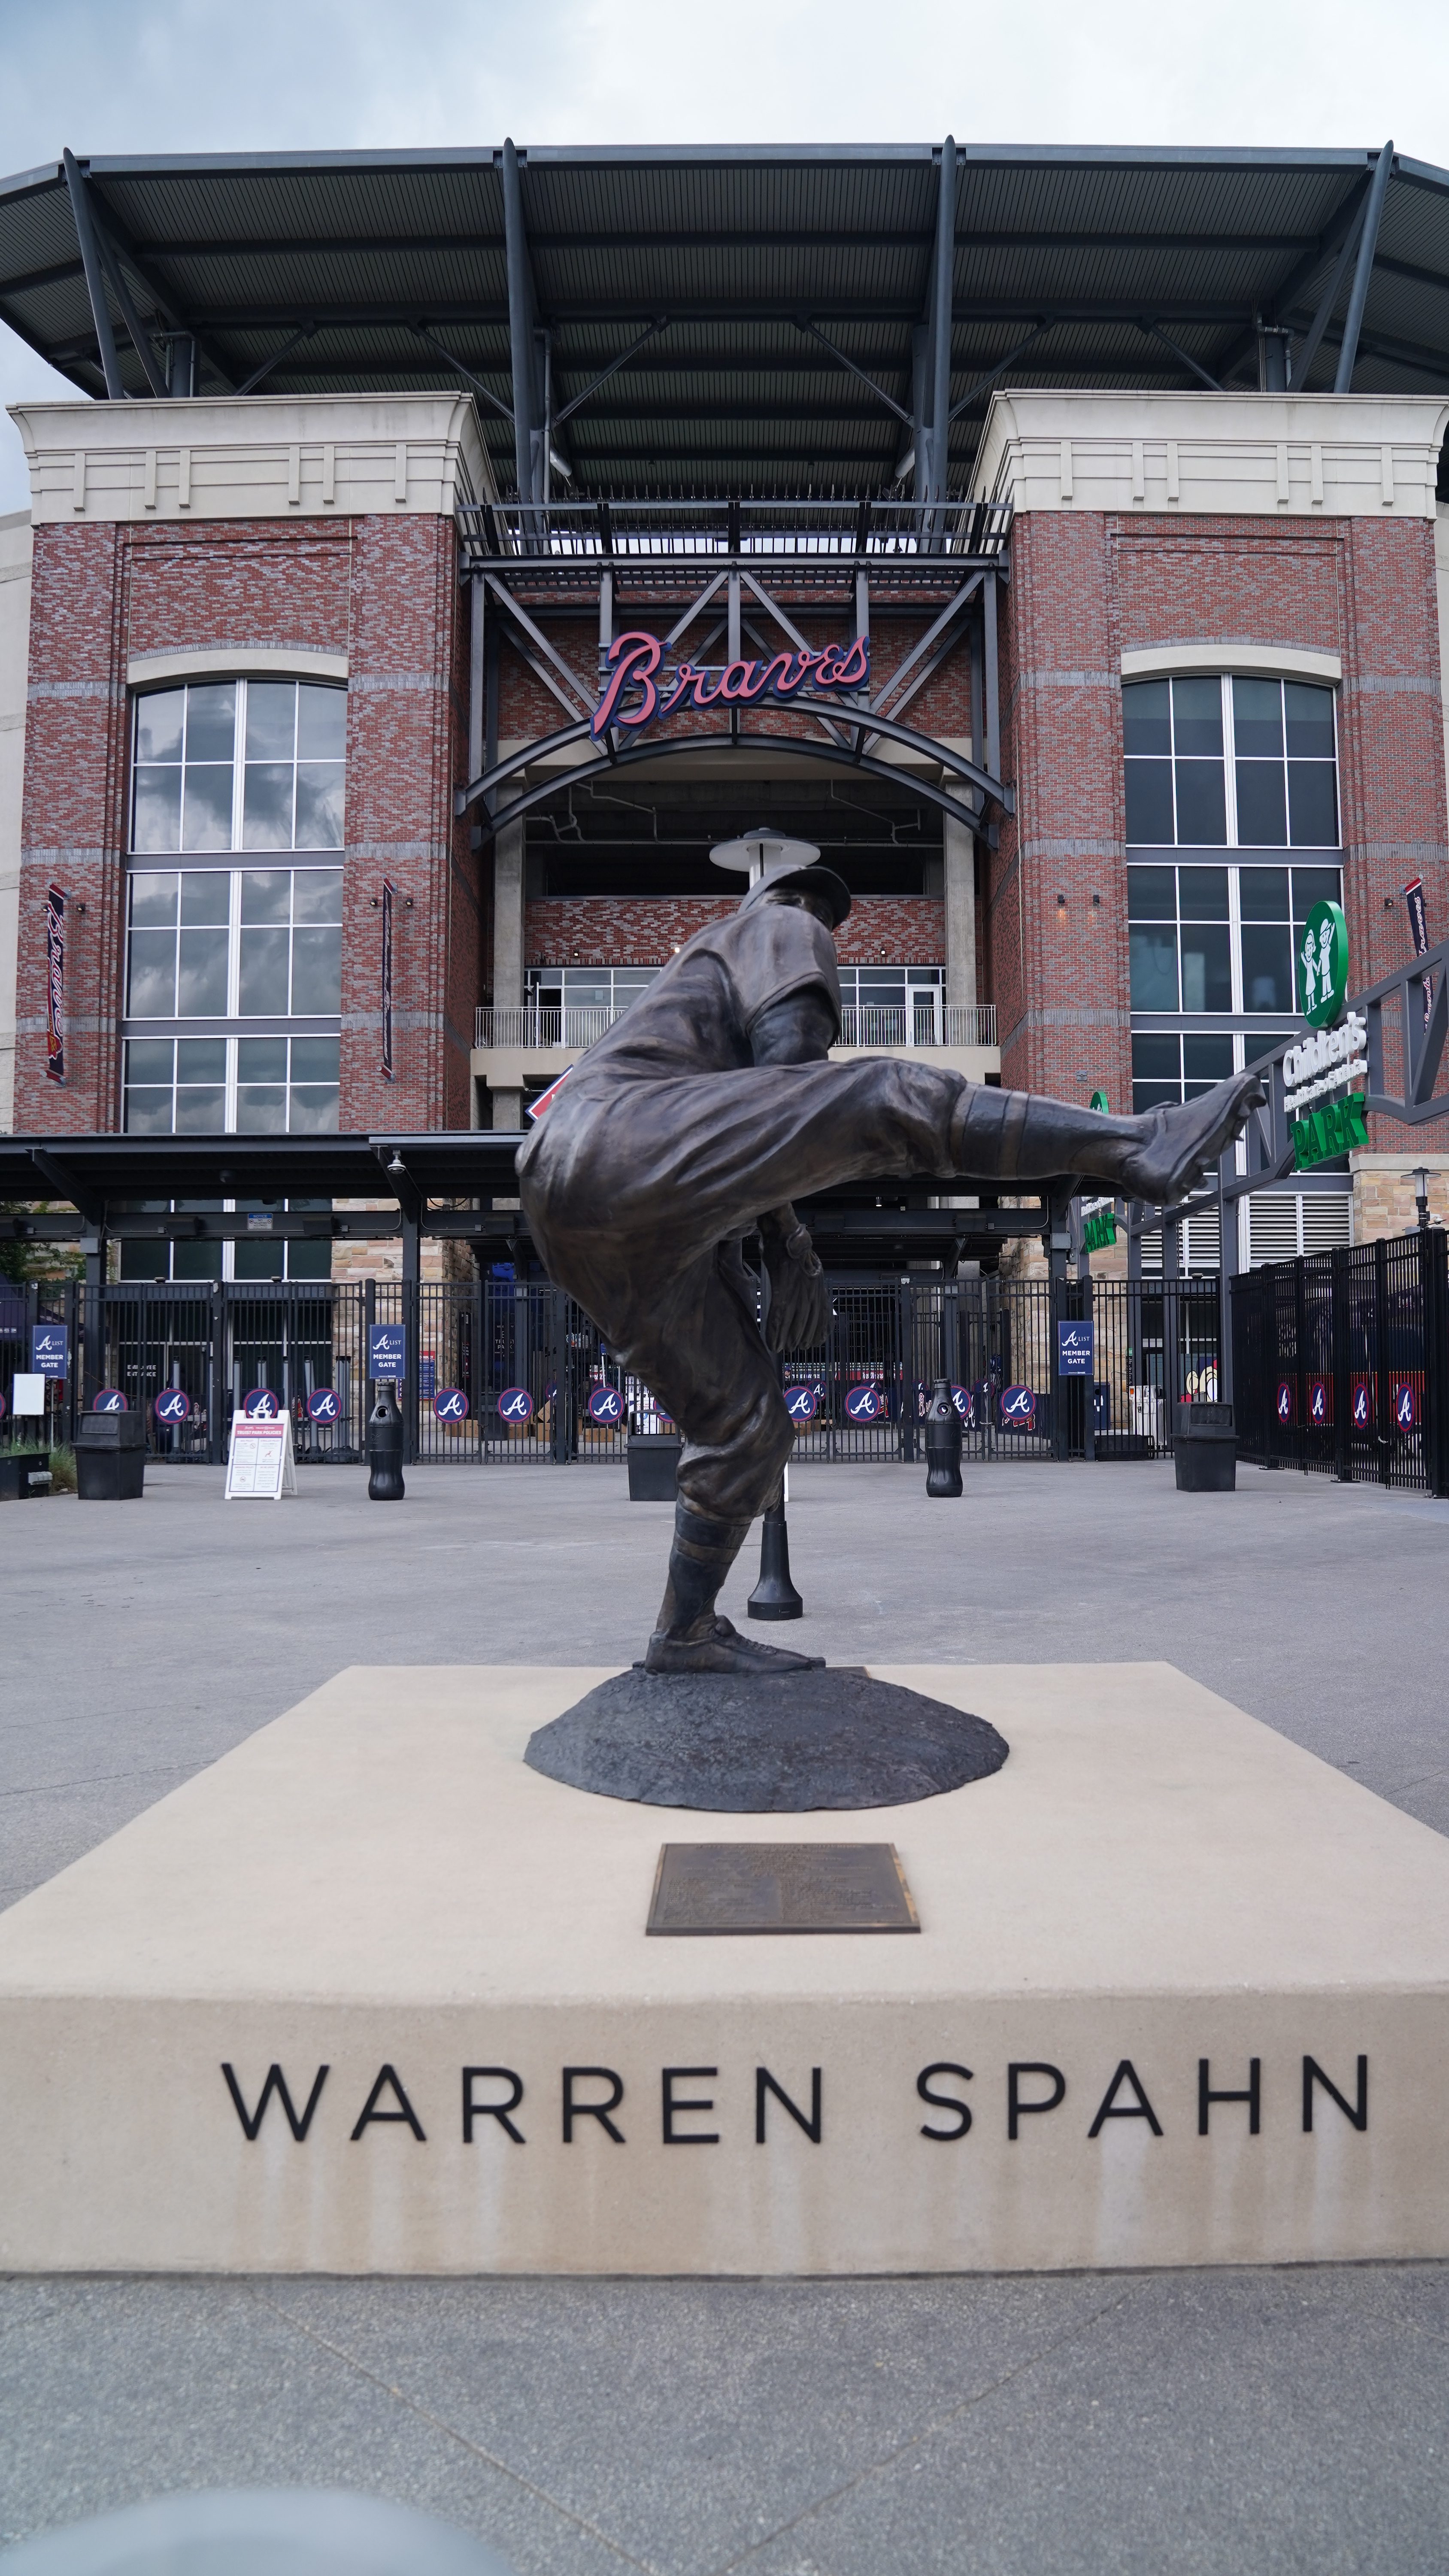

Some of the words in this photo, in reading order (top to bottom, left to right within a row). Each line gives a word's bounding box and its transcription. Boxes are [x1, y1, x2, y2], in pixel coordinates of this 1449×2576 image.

[590, 631, 871, 741] Braves
[1283, 1011, 1367, 1087] Children's
[1284, 1082, 1326, 1113] Healthcare
[1334, 1059, 1367, 1087] Atlanta
[1290, 1093, 1369, 1171] PARK
[1084, 1213, 1116, 1254] PARK
[36, 1335, 52, 1351] A
[373, 1334, 390, 1350] A
[1061, 1331, 1079, 1346] A
[221, 2063, 821, 2144] WARREN
[916, 2054, 1367, 2142] SPAHN
